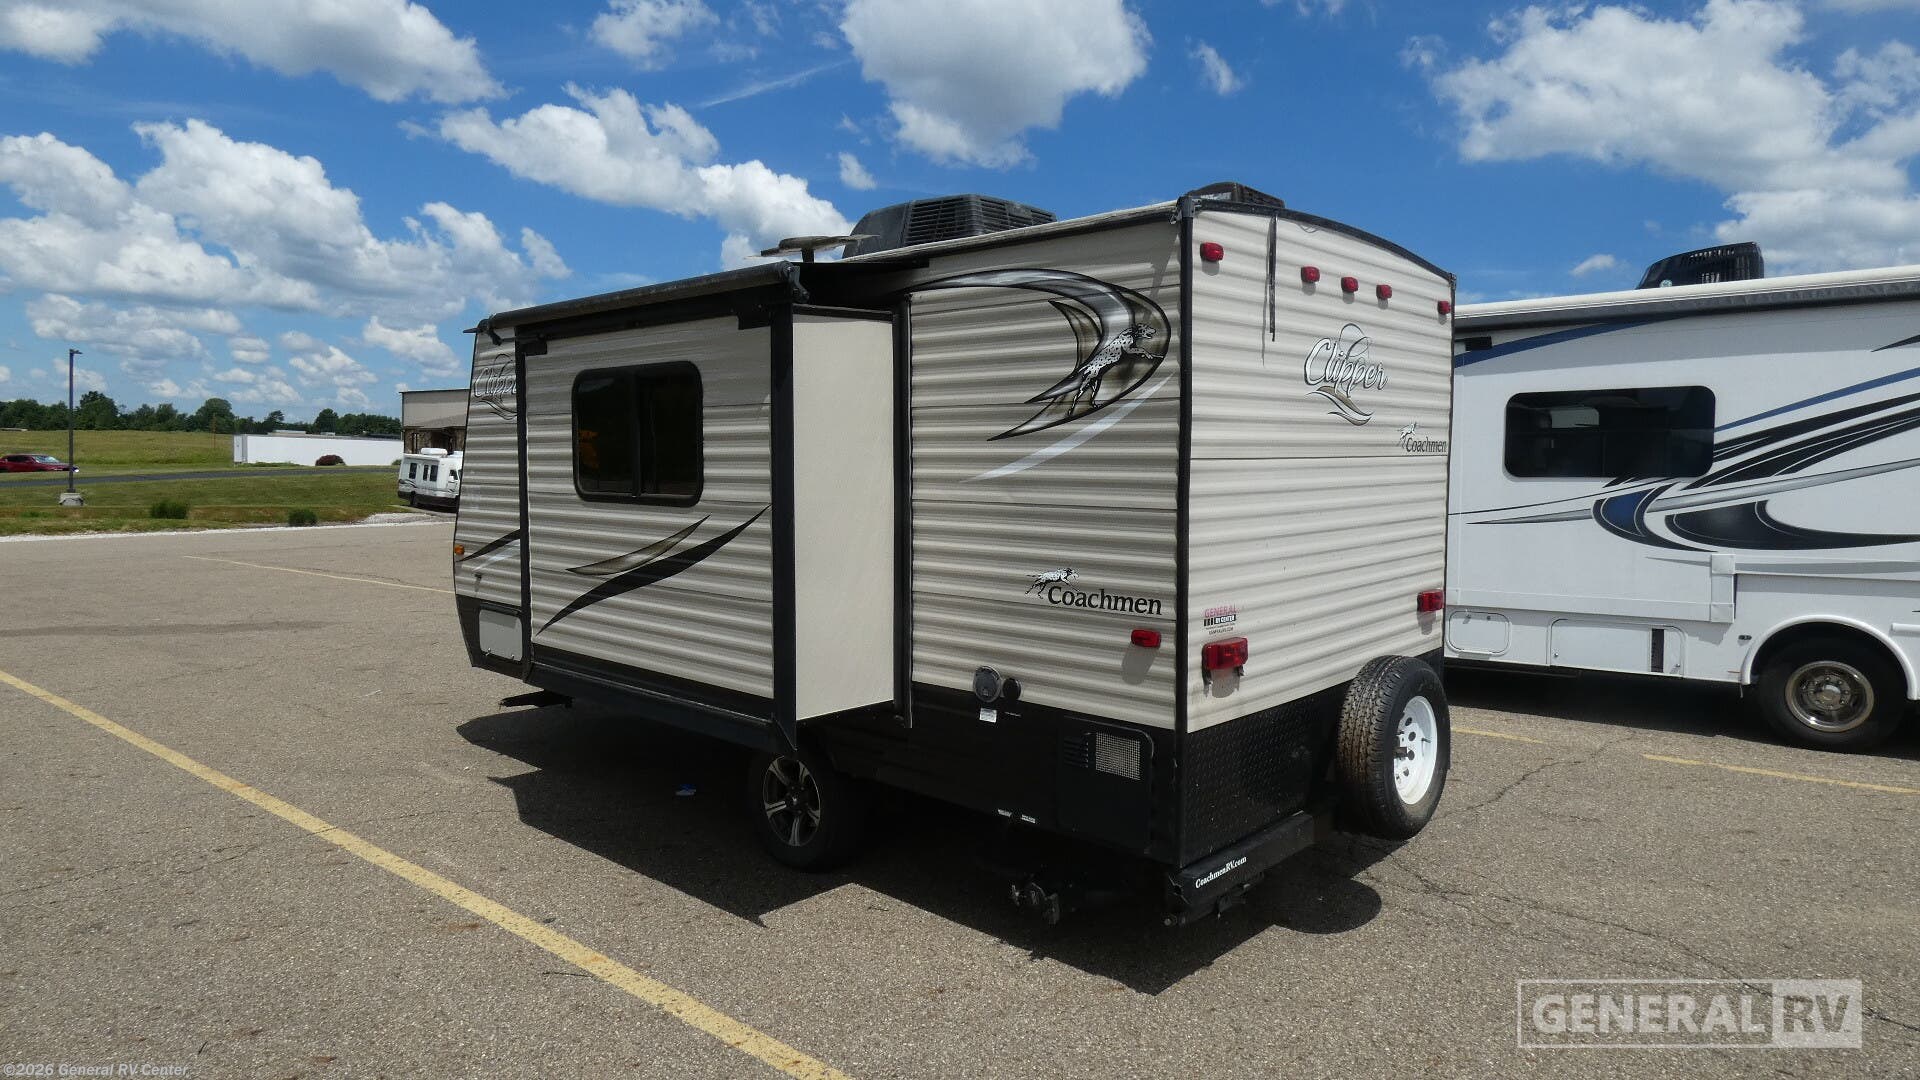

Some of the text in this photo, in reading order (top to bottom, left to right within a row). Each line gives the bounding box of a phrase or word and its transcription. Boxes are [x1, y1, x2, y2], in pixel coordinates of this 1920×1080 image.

[1304, 337, 1388, 399] Clipper
[473, 366, 517, 402] Clipp
[1405, 437, 1447, 453] Coachmen
[1047, 586, 1162, 616] Coachmen
[1204, 605, 1237, 618] GENERAL
[1195, 856, 1247, 889] CoachmenRV.com
